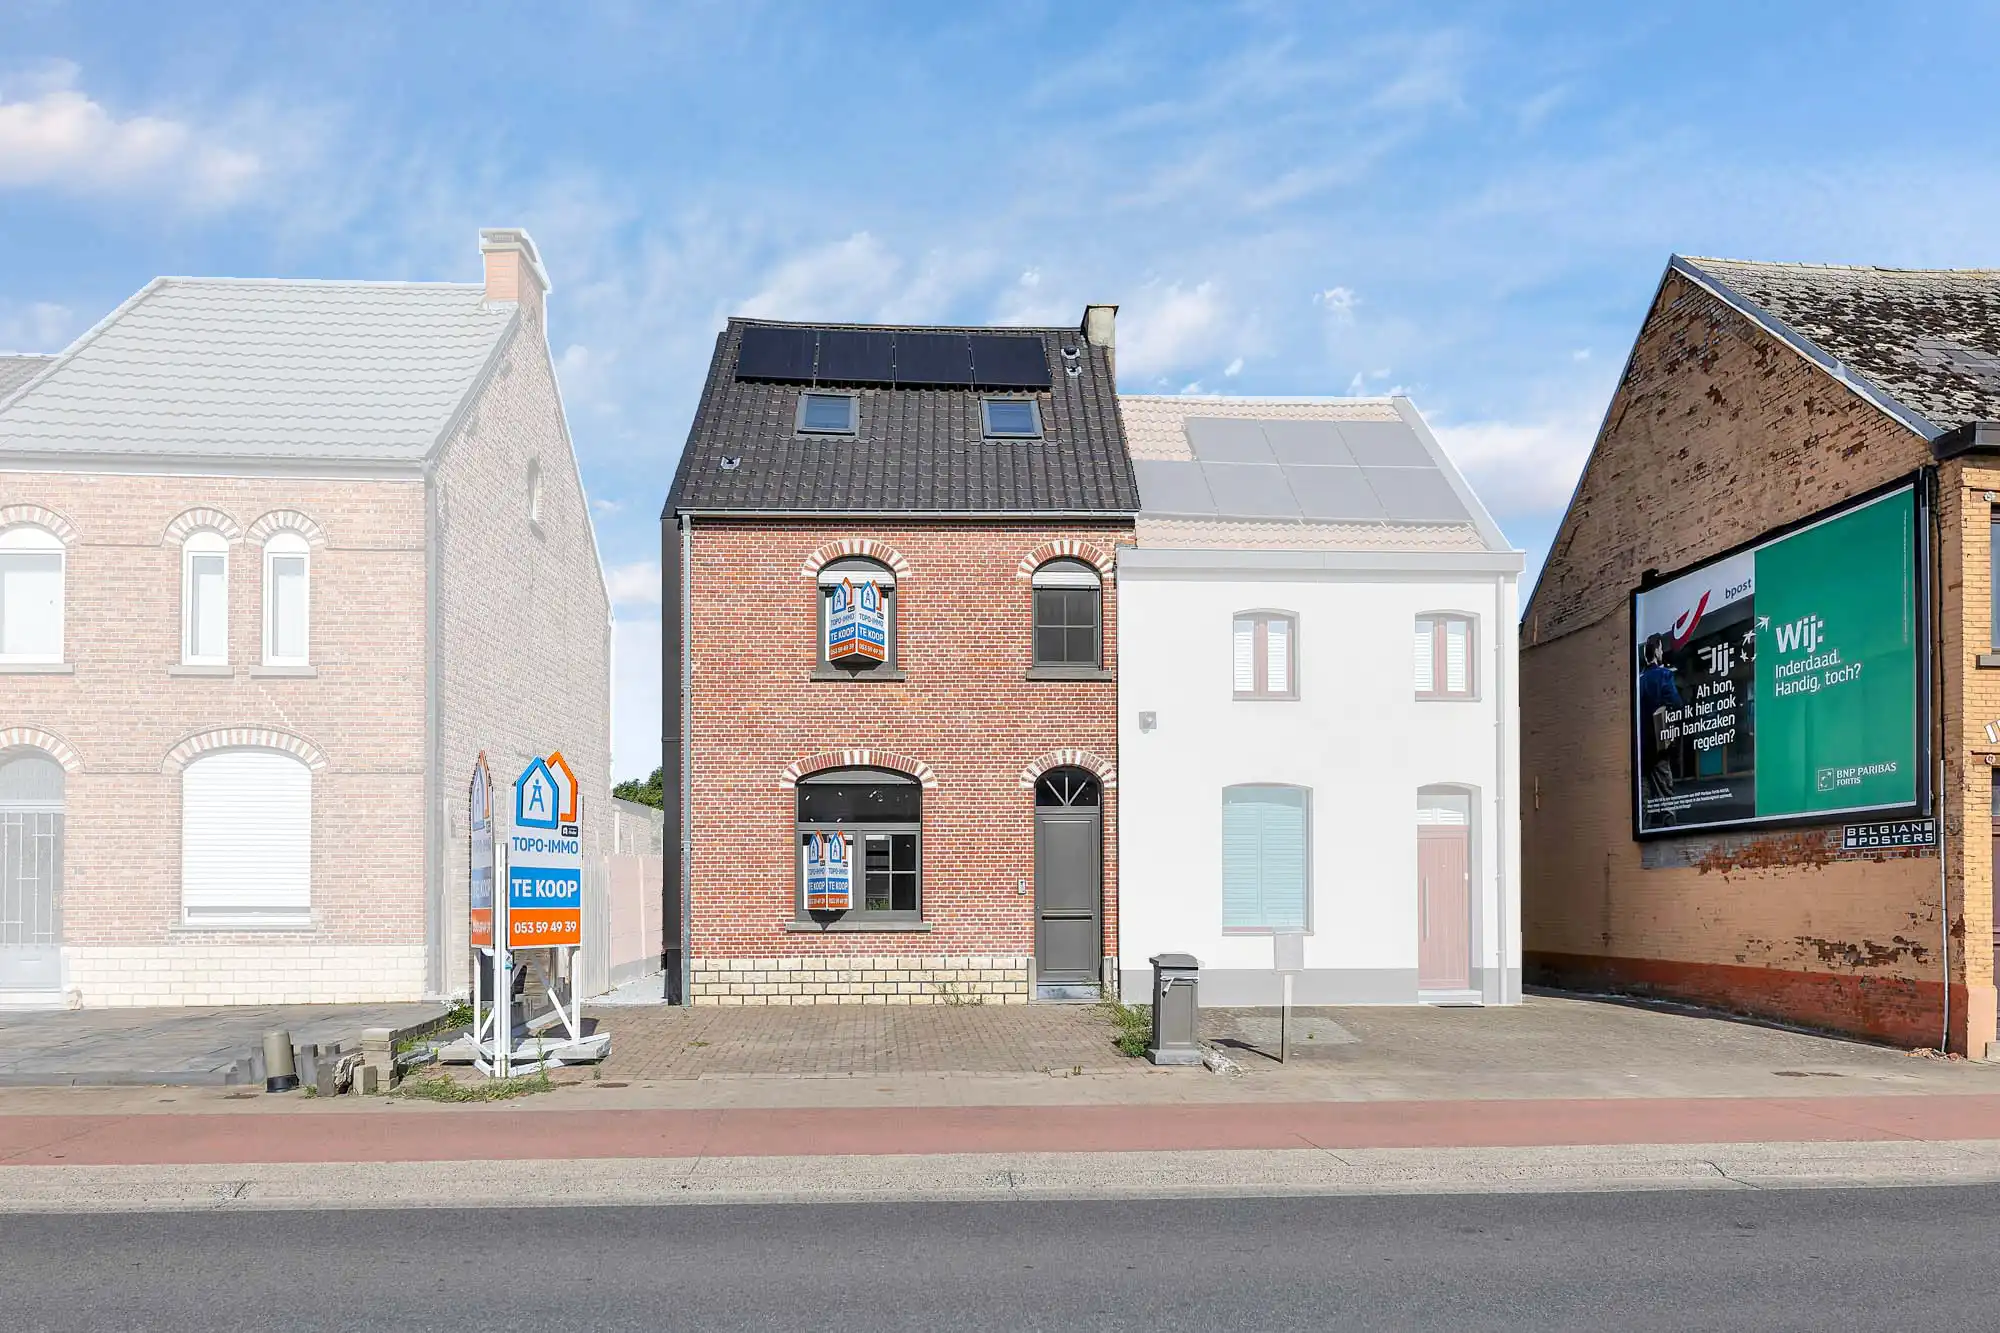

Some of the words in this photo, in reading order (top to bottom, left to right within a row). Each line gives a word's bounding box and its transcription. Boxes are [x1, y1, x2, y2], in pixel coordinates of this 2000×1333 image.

[1725, 579, 1752, 600] bpost
[1775, 614, 1823, 654] Wij:
[1775, 648, 1841, 678] Inderdaad.
[1696, 685, 1710, 699] Ah
[1713, 679, 1735, 696] bon,
[1775, 675, 1821, 696] Handig,
[1825, 663, 1861, 685] toch?
[1665, 707, 1682, 723] kan
[1685, 704, 1694, 718] ik
[1695, 700, 1713, 716] hier
[1717, 694, 1736, 710] ook
[1660, 725, 1680, 743] mijn
[1682, 714, 1735, 736] bankzaken
[1693, 728, 1735, 751] regelen?
[1836, 768, 1856, 779] BNP
[1858, 762, 1897, 776] PARIBAS
[1836, 777, 1861, 787] FORTIS
[1847, 823, 1922, 836] BELGIAN
[1859, 833, 1933, 846] POSTERS
[512, 836, 579, 854] TOPO-IMMO
[512, 878, 532, 897] TE
[535, 879, 578, 898] KOOP
[514, 921, 534, 934] 053
[536, 921, 548, 933] 59
[550, 921, 562, 933] 49
[564, 920, 577, 933] 39
